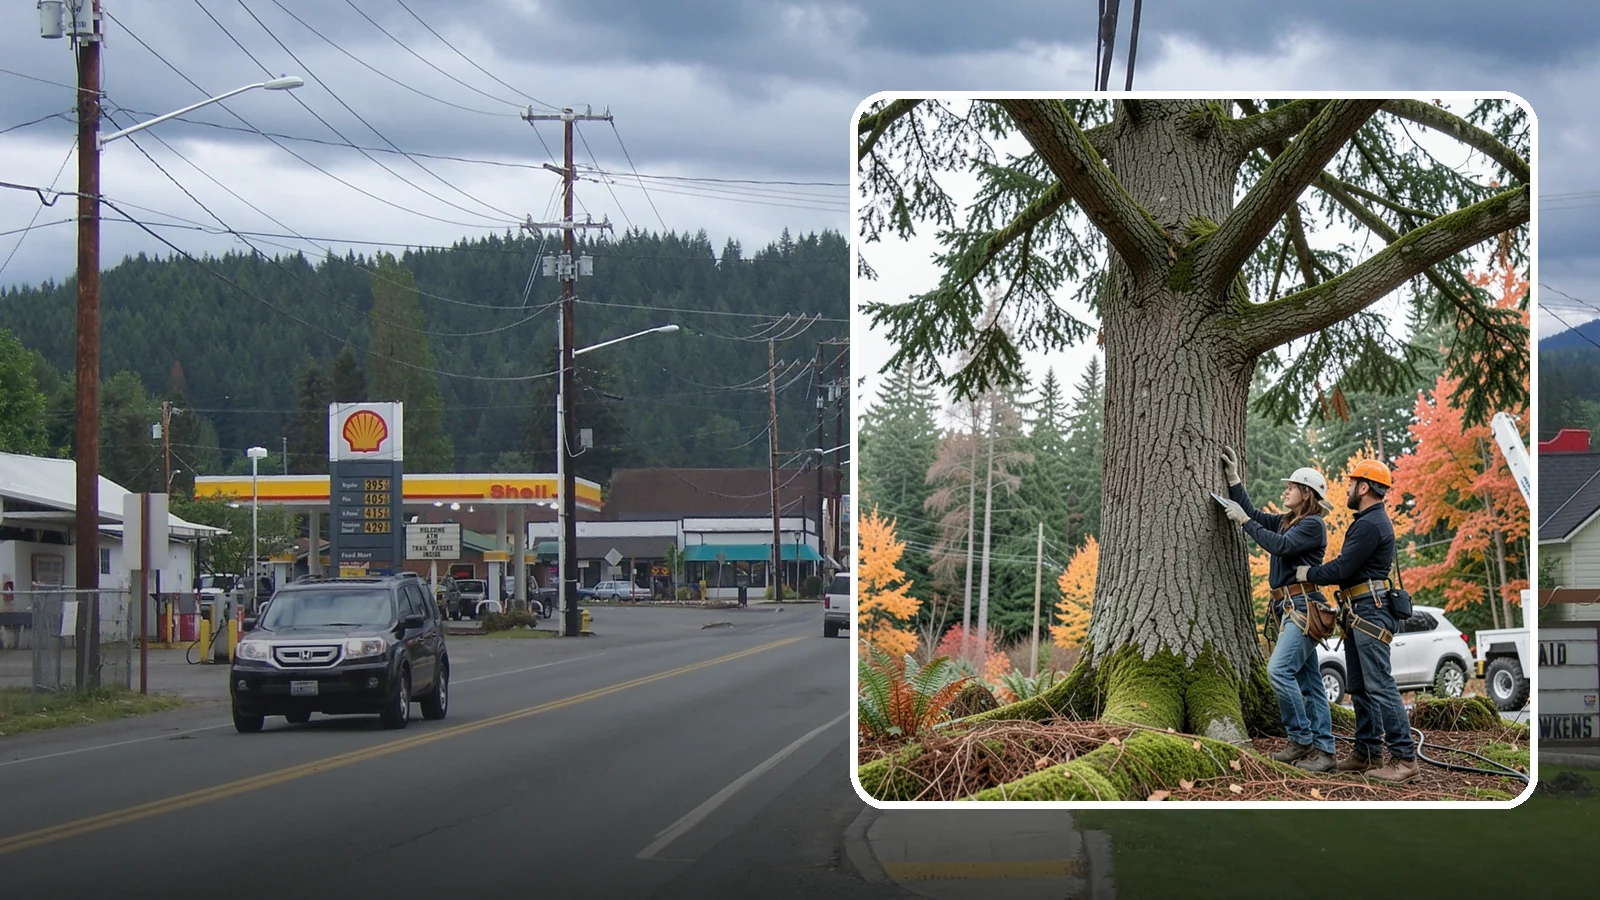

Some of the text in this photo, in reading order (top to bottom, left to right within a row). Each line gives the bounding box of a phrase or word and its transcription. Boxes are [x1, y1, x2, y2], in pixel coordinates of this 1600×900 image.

[366, 480, 383, 490] 395
[490, 484, 547, 499] Shell
[366, 494, 383, 504] 405
[366, 508, 383, 518] 415
[366, 522, 383, 532] 429
